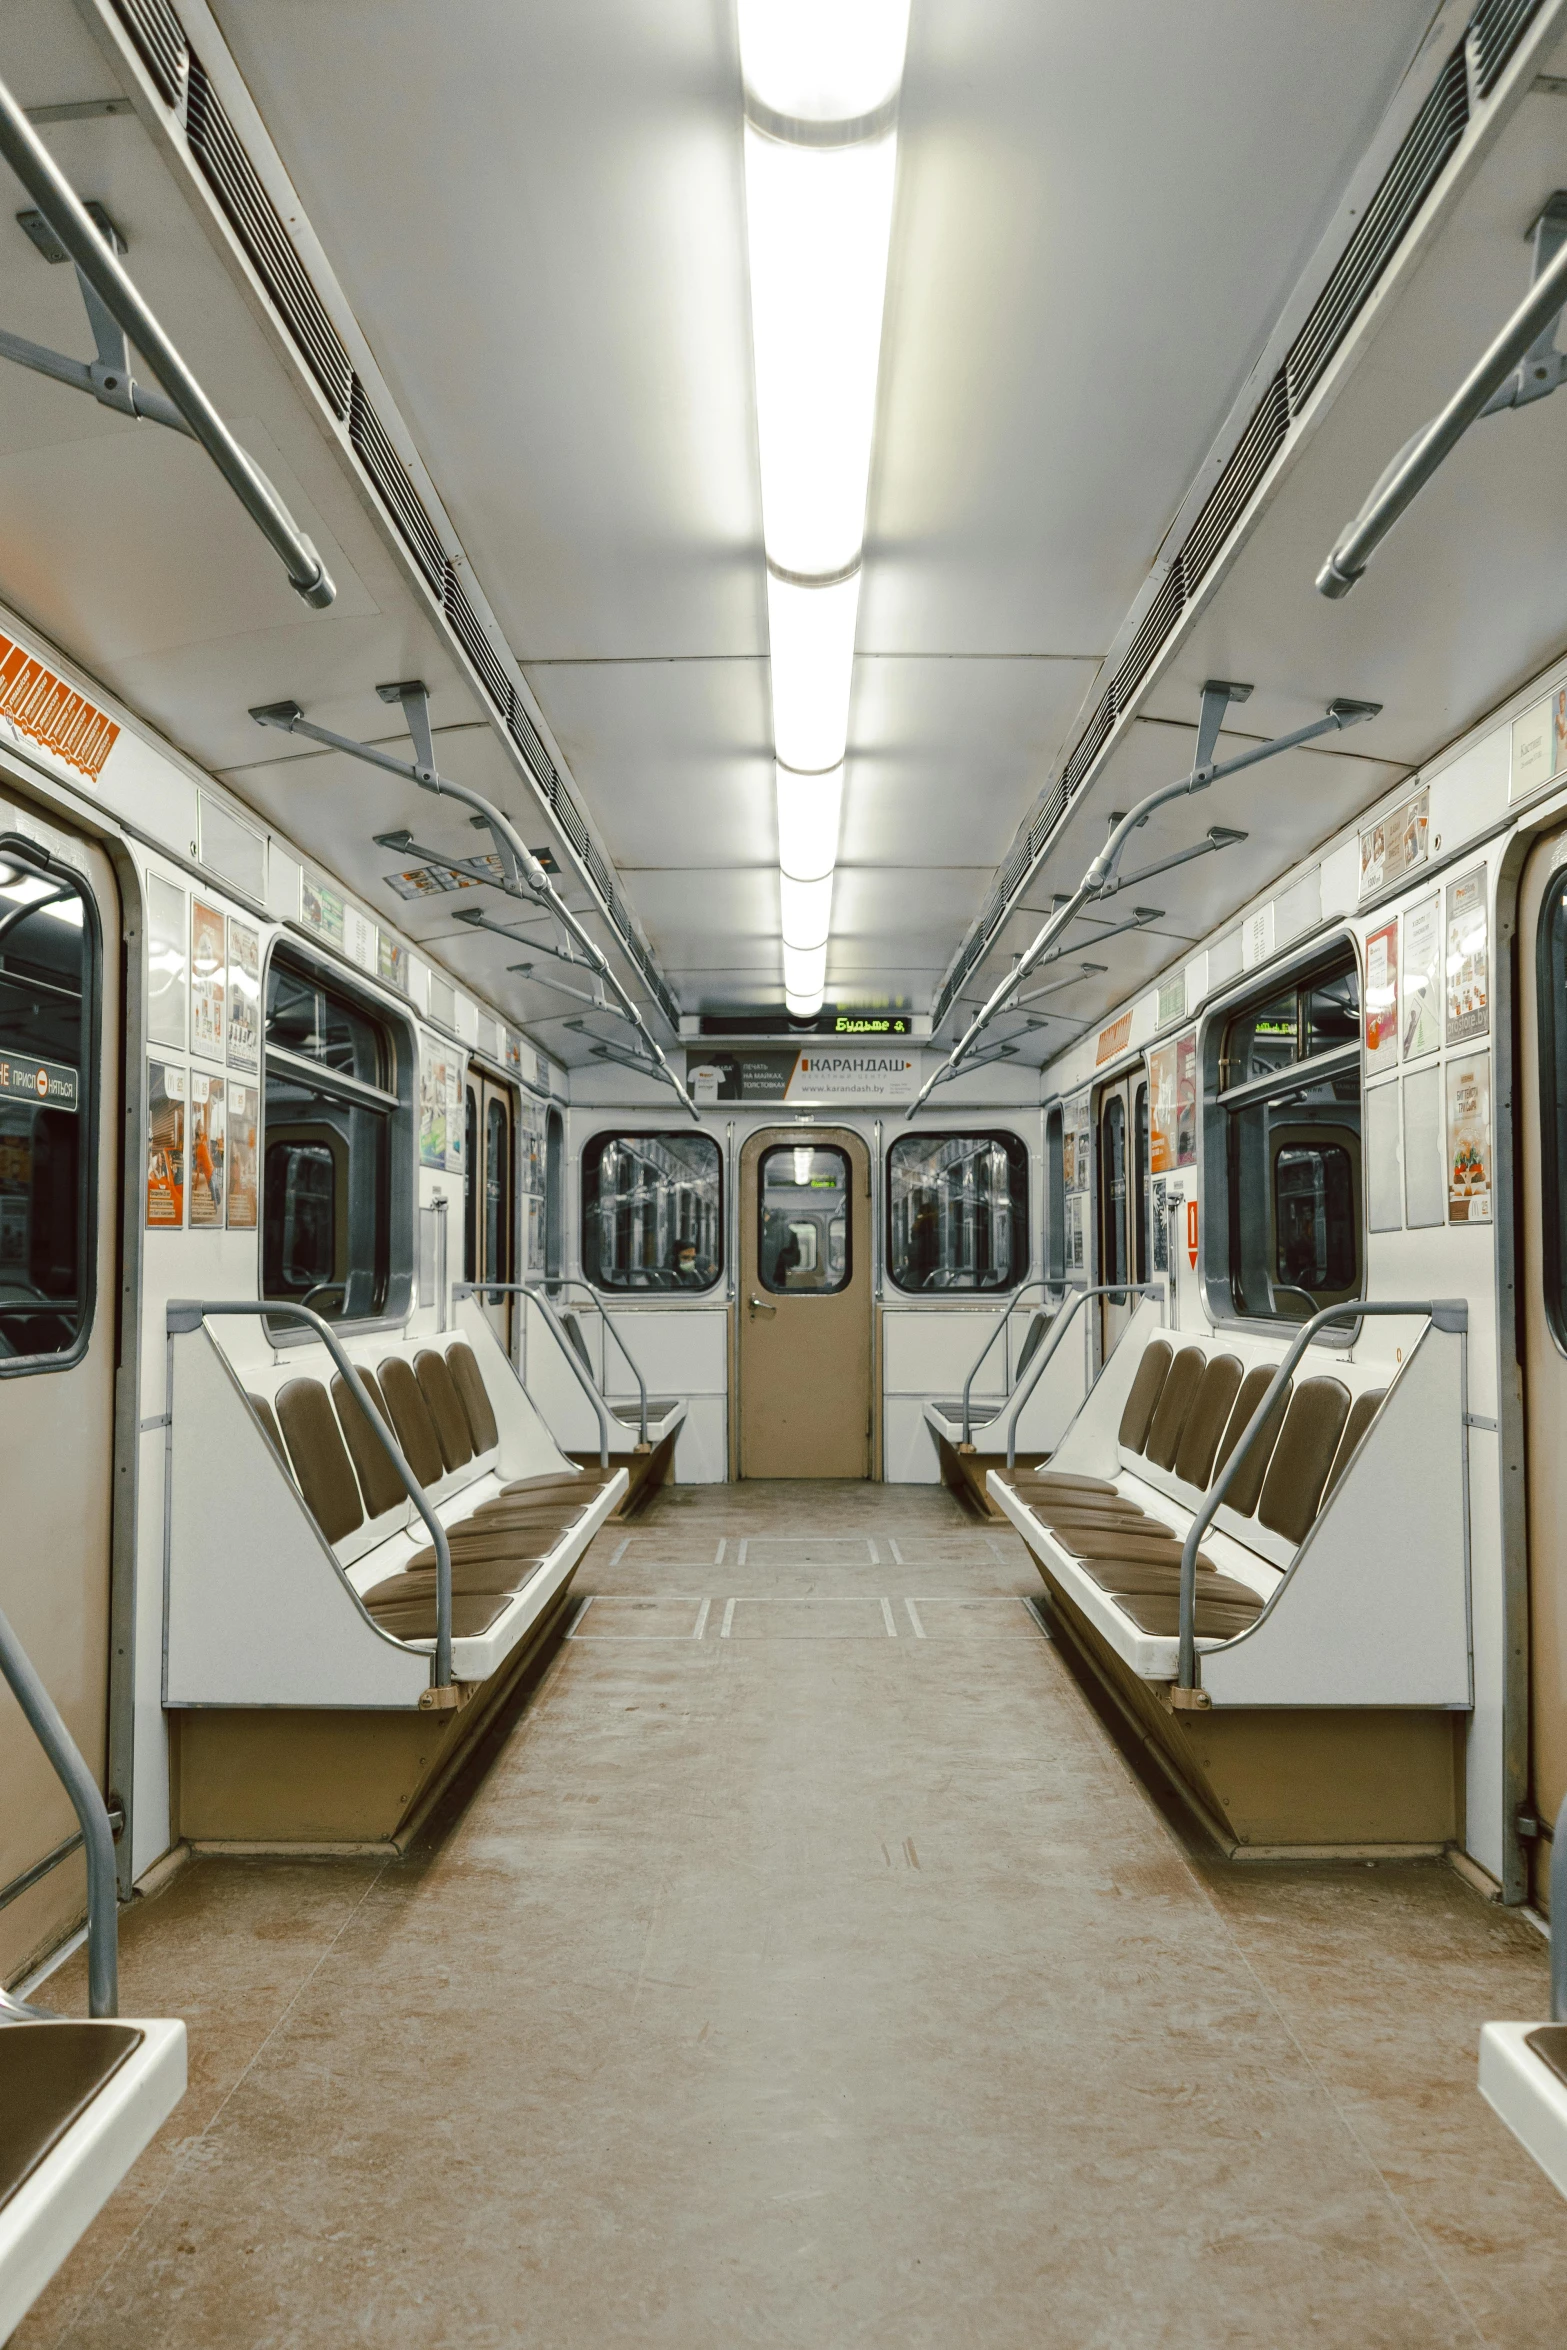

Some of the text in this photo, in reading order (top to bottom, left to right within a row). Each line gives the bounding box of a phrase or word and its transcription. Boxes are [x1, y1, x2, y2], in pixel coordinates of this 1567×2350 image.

[835, 1017, 890, 1033] Будьте
[1447, 1009, 1488, 1034] prostore.by
[810, 1059, 905, 1072] КАРАНДАШ
[801, 1084, 885, 1094] www.karandash.by
